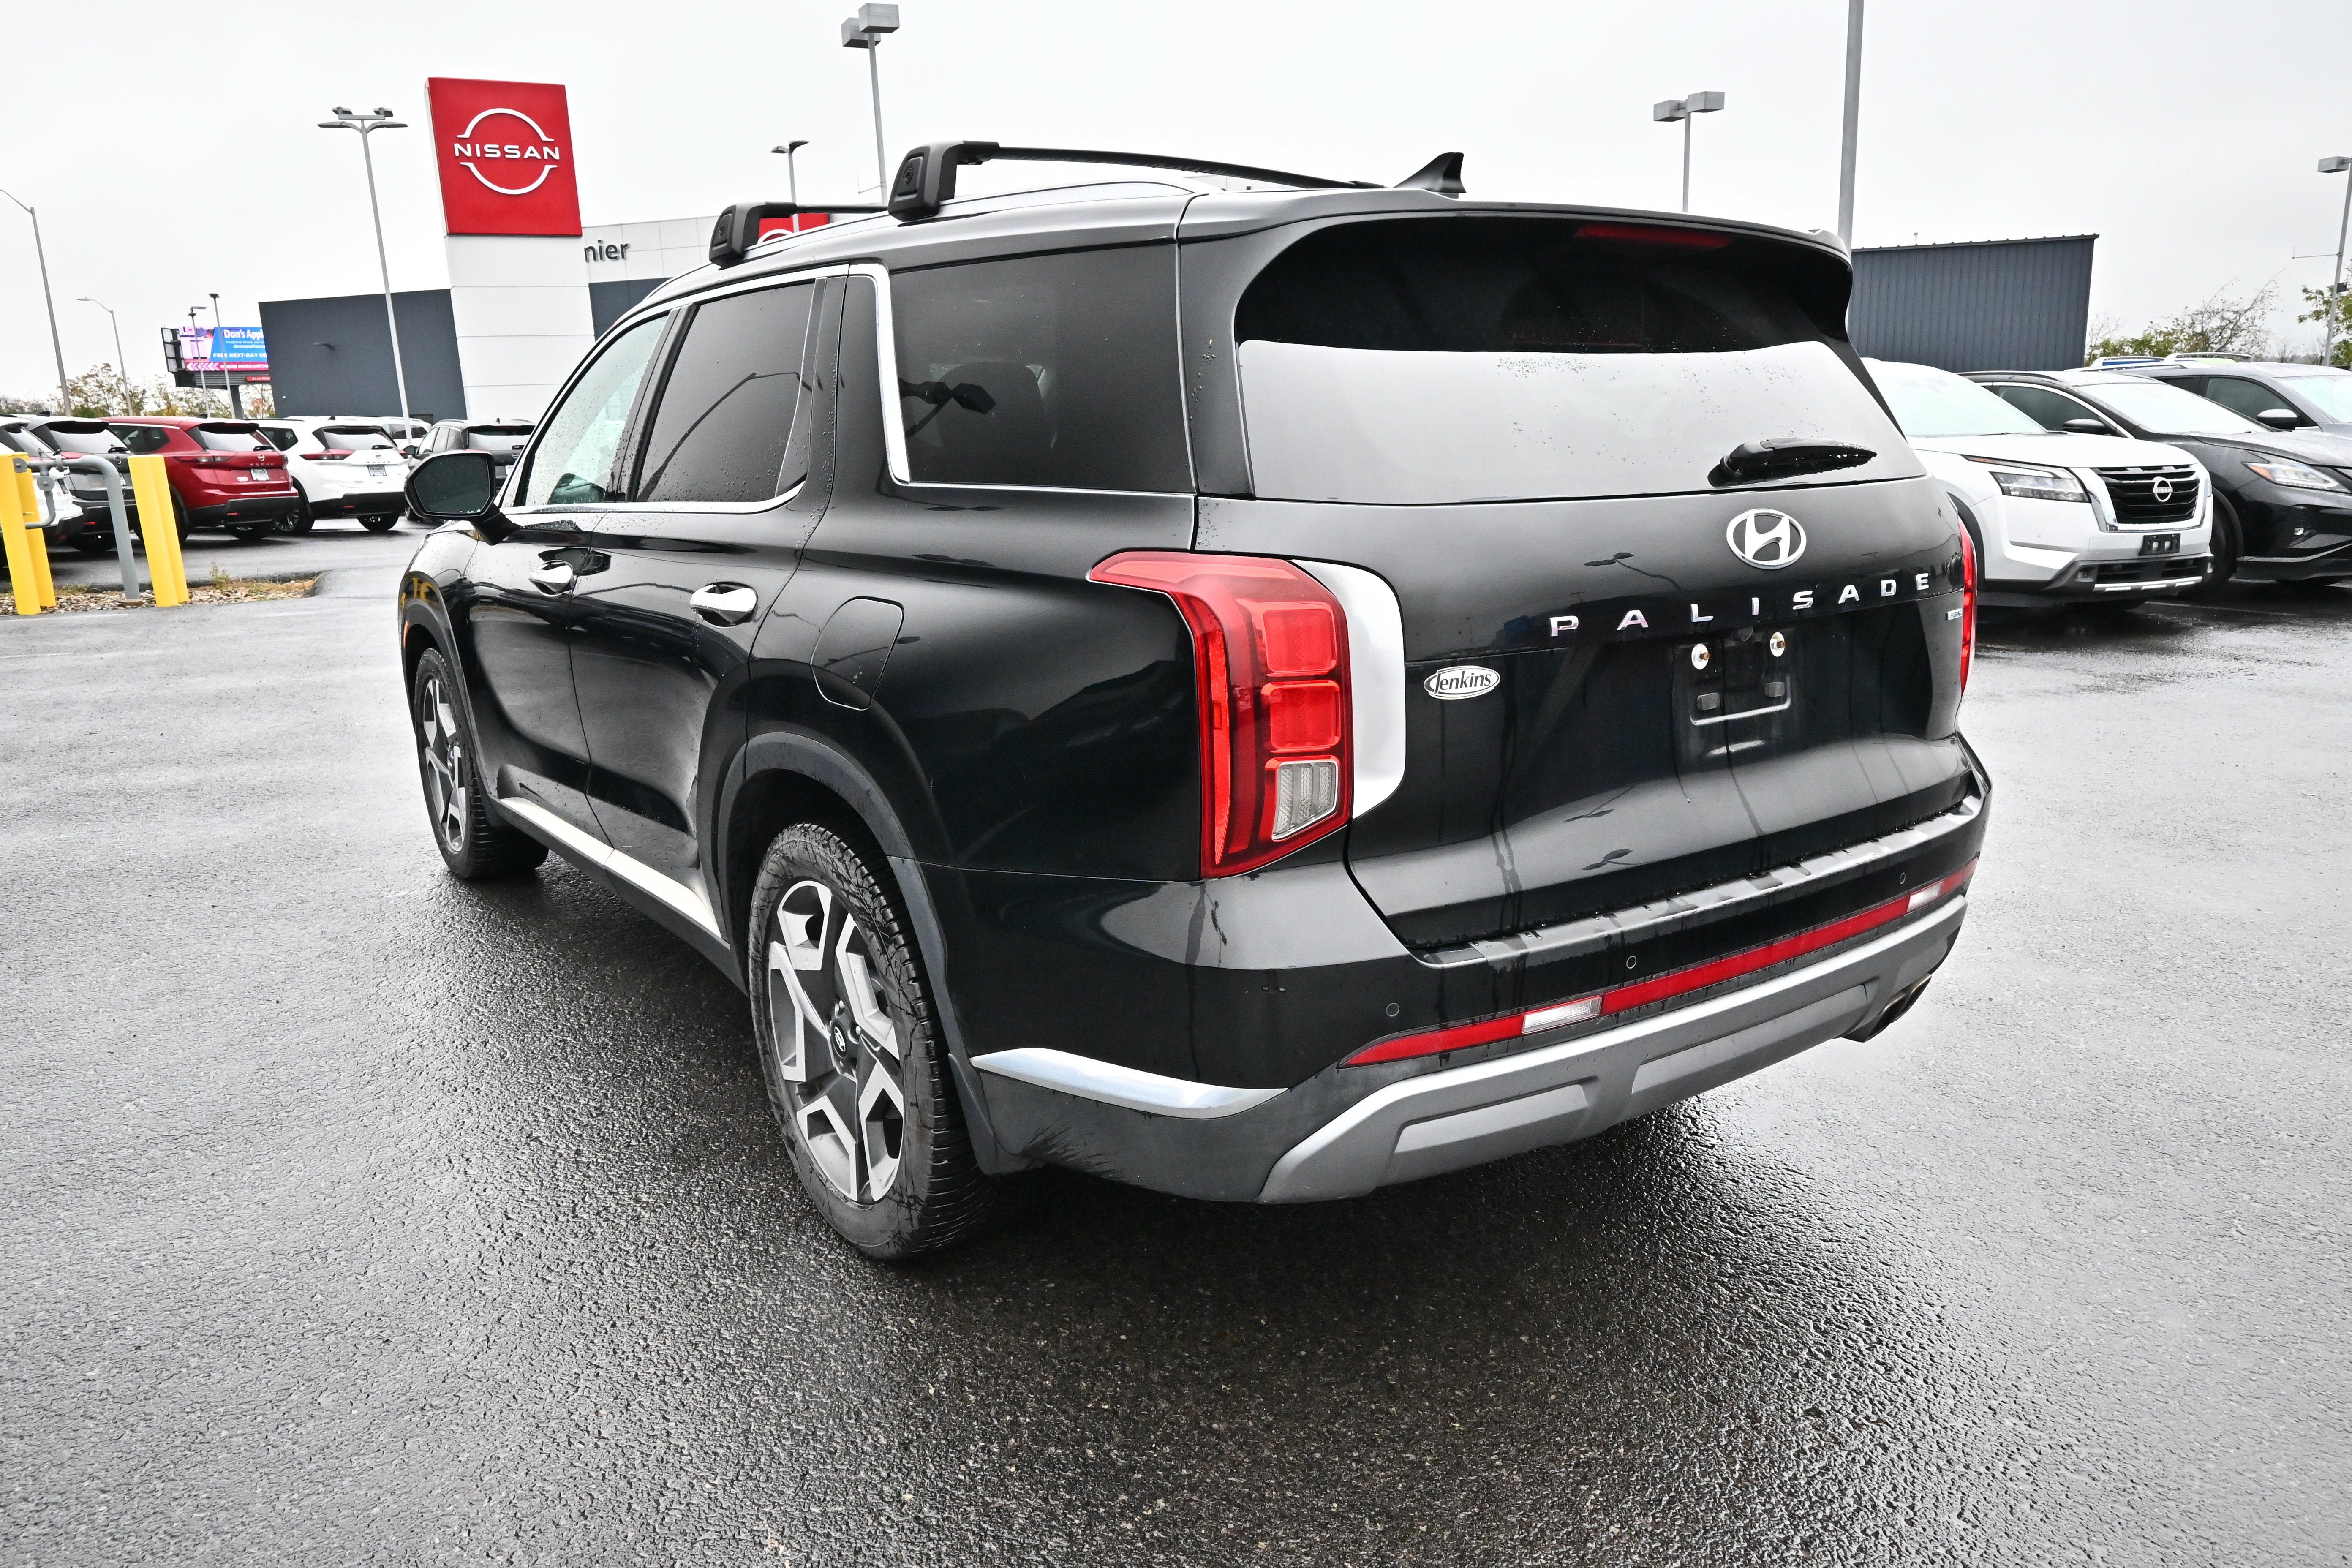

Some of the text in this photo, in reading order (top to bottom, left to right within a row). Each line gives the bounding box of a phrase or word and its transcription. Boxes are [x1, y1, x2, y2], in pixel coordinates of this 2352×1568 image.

[454, 143, 560, 160] NISSAN
[223, 329, 245, 338] Don's
[1549, 572, 1929, 637] PALISADE
[1433, 670, 1492, 695] Jenkins
